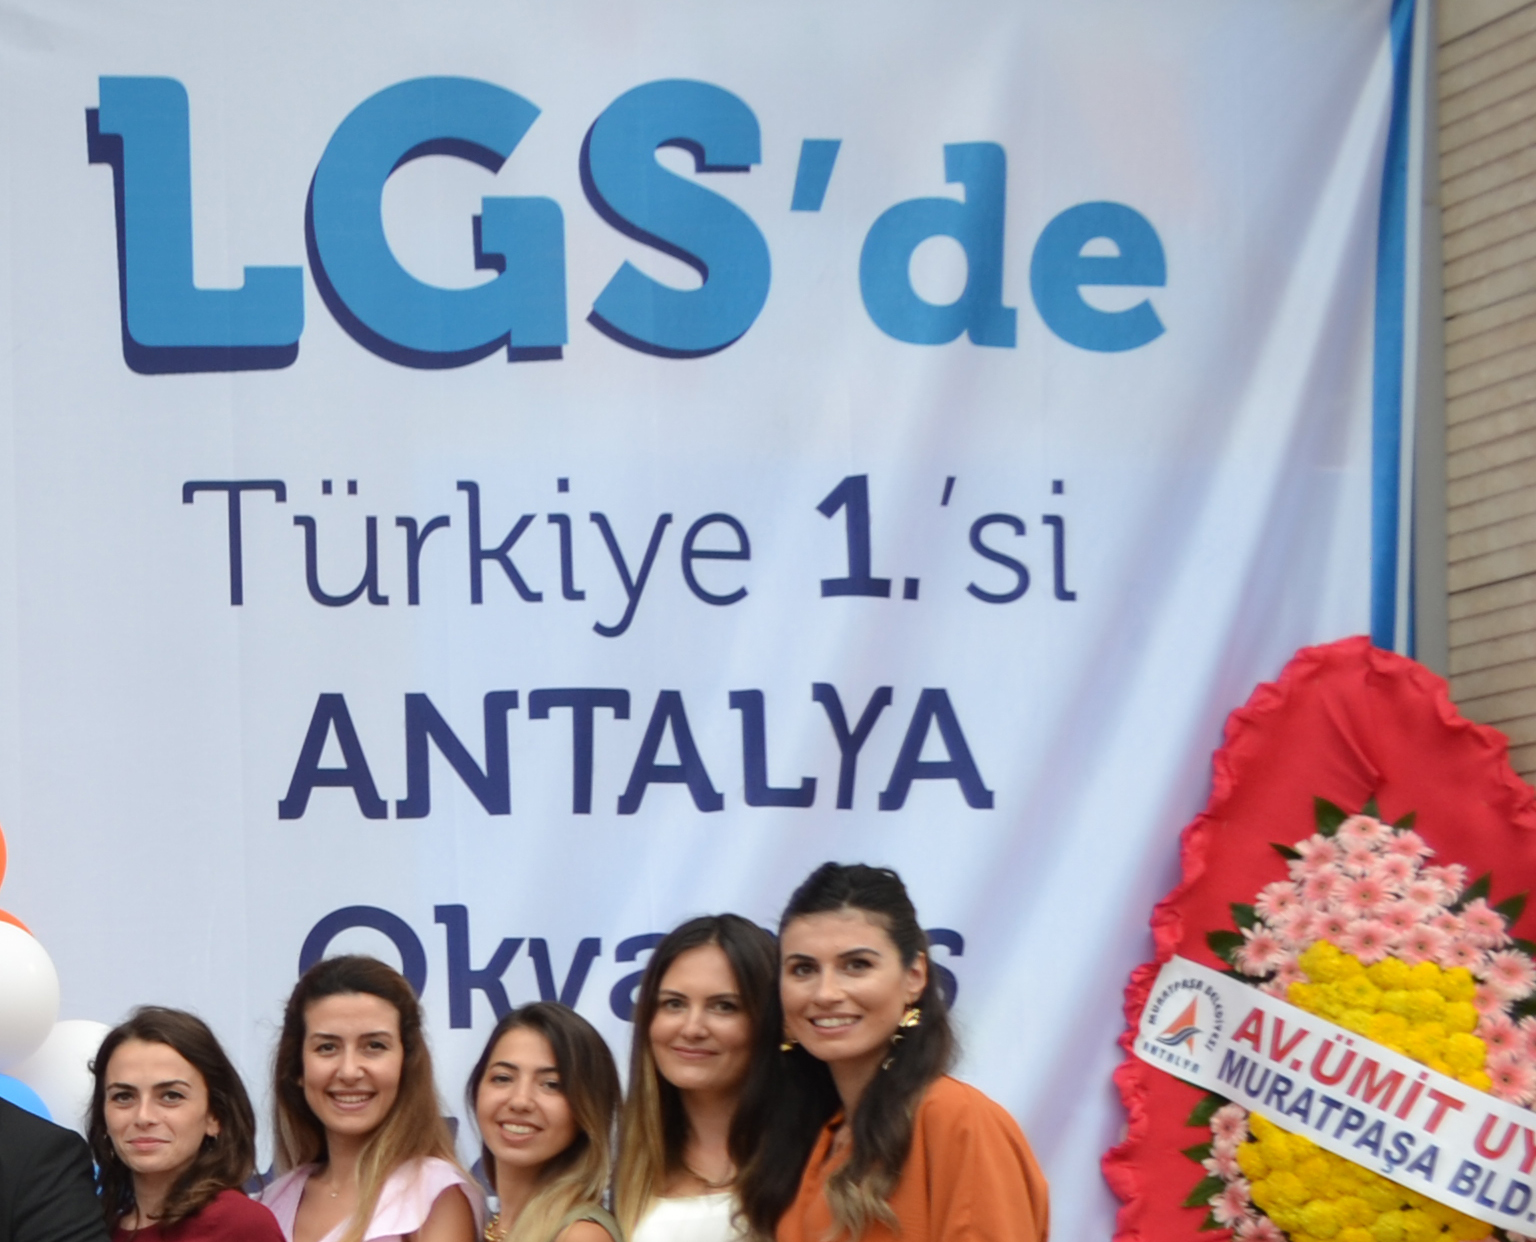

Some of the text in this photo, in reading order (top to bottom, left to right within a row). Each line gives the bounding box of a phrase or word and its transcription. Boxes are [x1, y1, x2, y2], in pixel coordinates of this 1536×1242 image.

[84, 74, 1169, 376] LGS'de
[182, 476, 752, 639] Türkiye
[277, 681, 996, 821] ANTALYA
[297, 903, 966, 1030] Okyas
[1141, 1040, 1202, 1075] ANTALYA
[1216, 1047, 1536, 1224] MURATPAŞA BLD.
